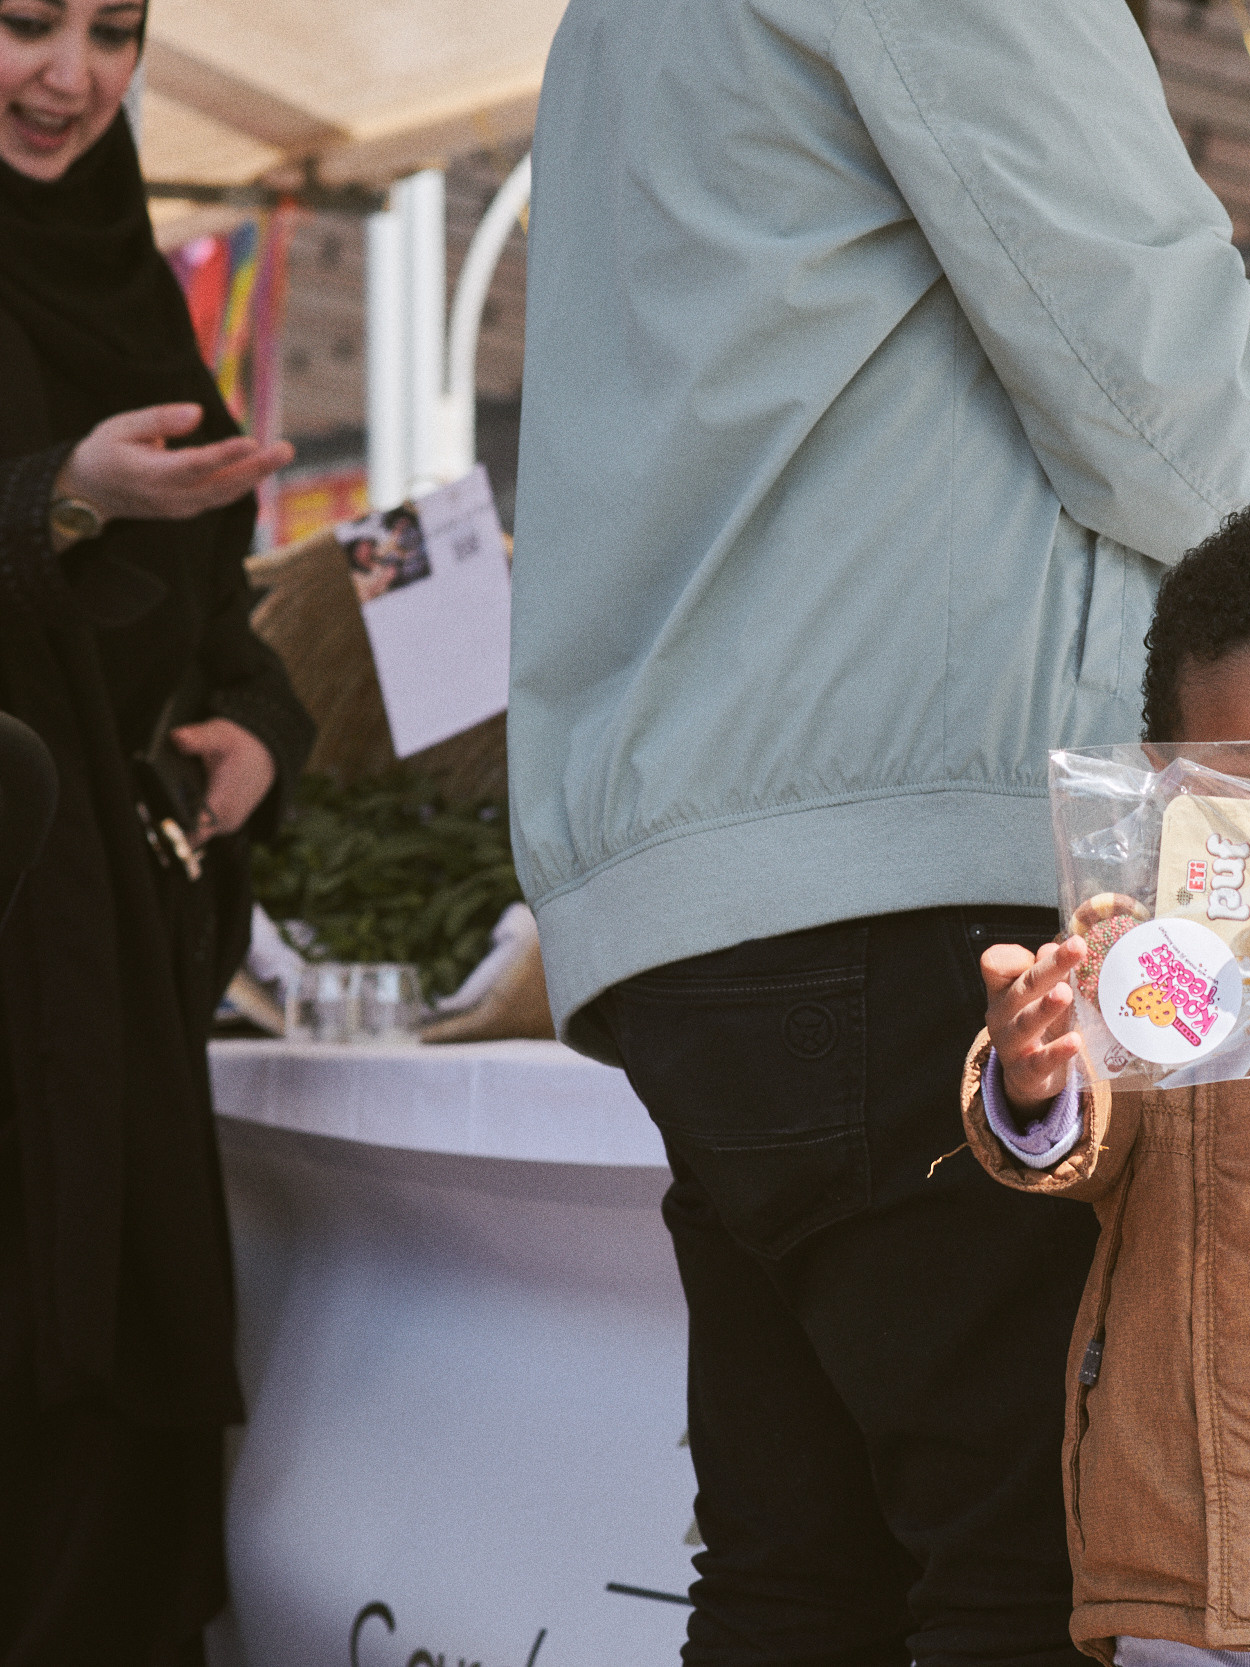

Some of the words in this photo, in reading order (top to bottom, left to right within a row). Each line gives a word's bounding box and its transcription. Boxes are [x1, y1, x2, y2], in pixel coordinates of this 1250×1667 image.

[1206, 833, 1250, 921] puf
[1138, 952, 1218, 1037] Koekjes
[1152, 943, 1217, 1011] feest!
